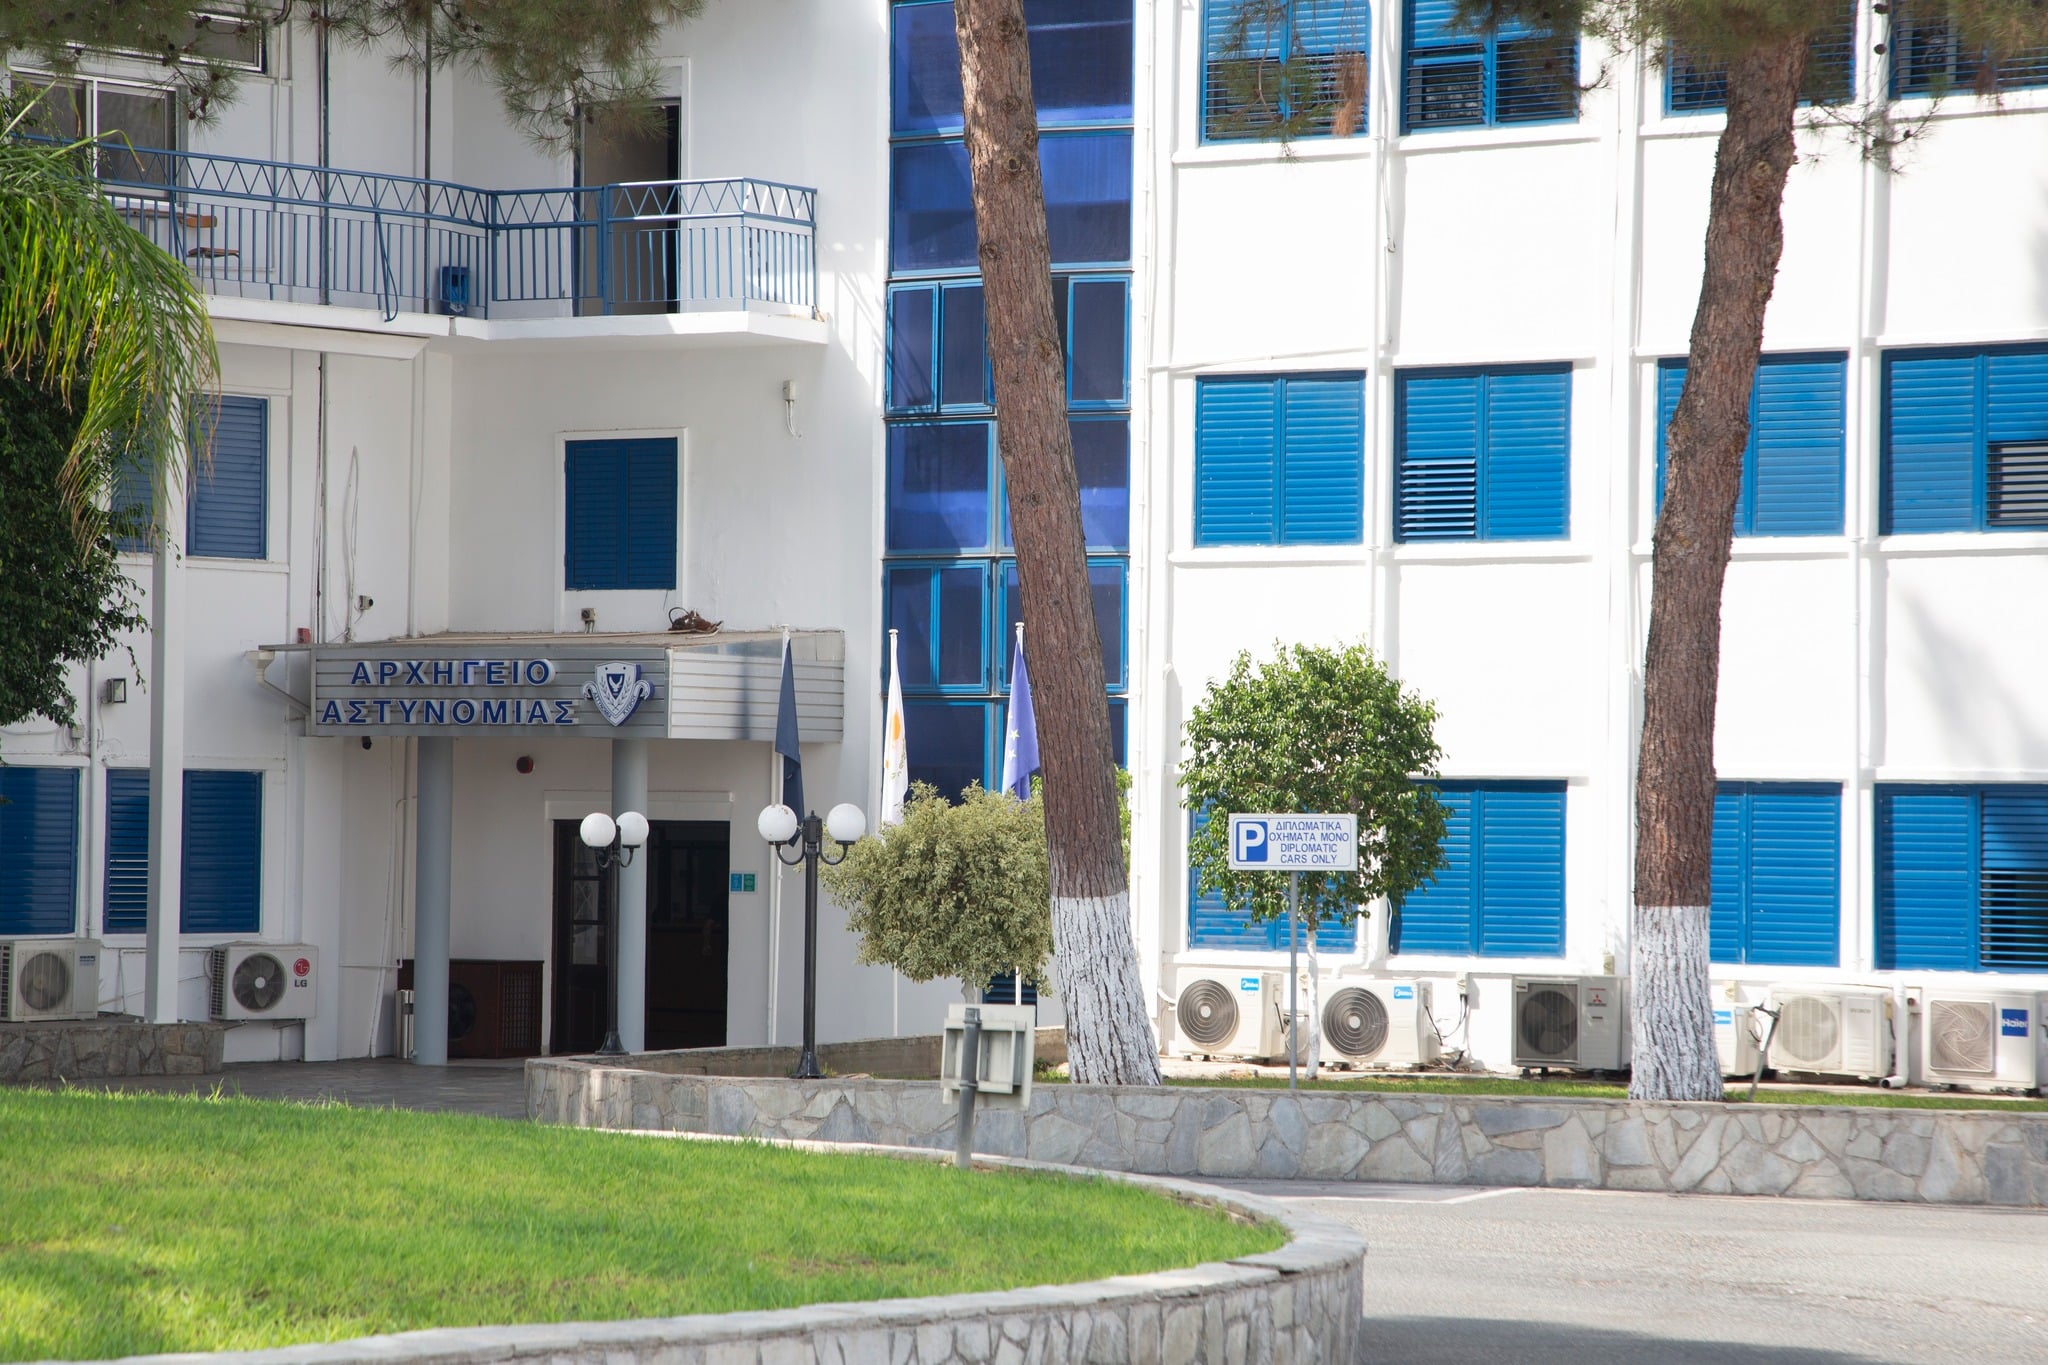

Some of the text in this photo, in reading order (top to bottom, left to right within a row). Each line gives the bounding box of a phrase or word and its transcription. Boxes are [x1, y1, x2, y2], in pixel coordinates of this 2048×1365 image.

[351, 660, 552, 686] ΑΡΧΗΓΕΙΟ
[322, 699, 575, 725] ΑΣΤΥΝΟΜΙΑΣ
[1275, 821, 1342, 831] ΔΙΠΛΩΜΑΤΙΚΑ
[1239, 823, 1266, 861] P
[1269, 832, 1349, 842] ΟΧΗΜΑΤΑ ΜΟΝΟ
[1280, 843, 1338, 853] DIPLOMATIC
[1280, 854, 1337, 864] CARS ONLY
[294, 979, 308, 988] LG
